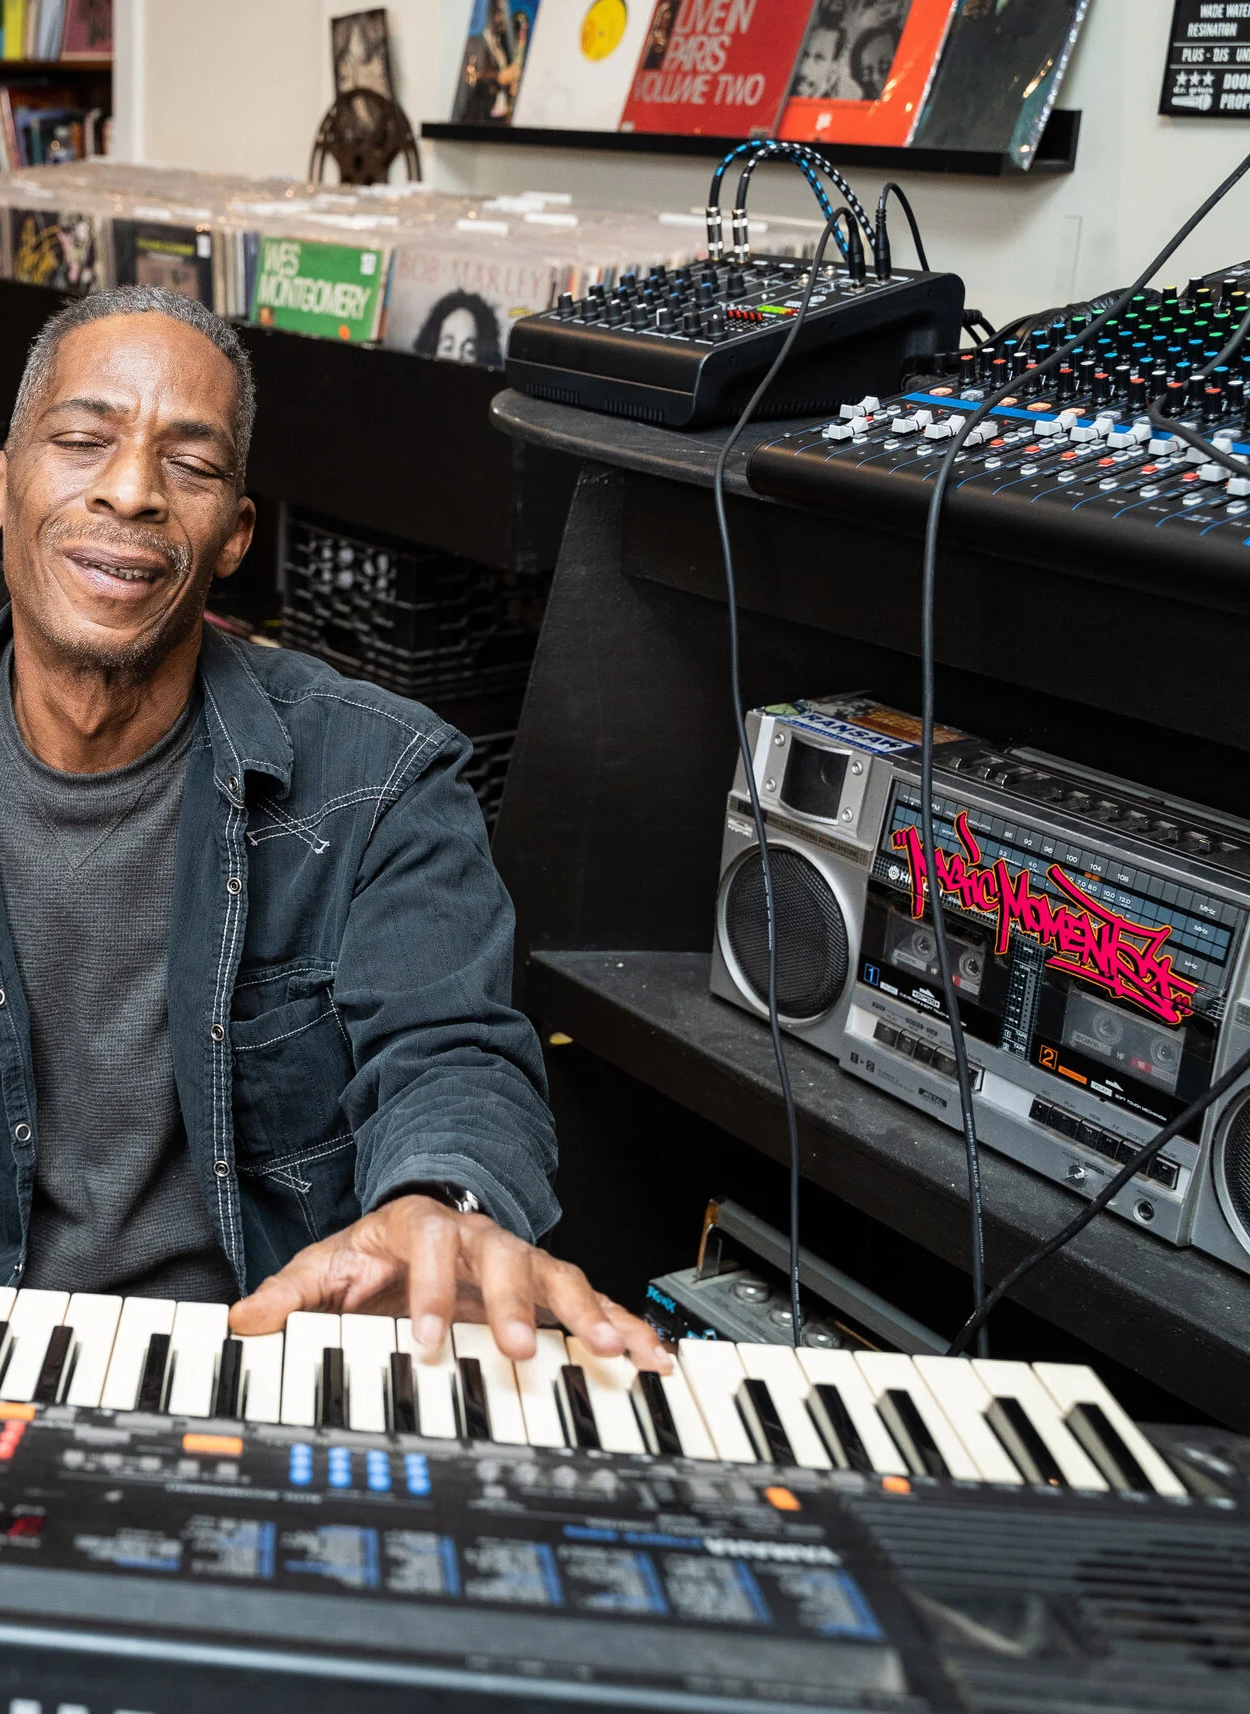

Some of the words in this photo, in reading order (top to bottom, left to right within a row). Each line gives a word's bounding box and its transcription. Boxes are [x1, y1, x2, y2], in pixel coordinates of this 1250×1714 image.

[674, 0, 731, 34] LIVE
[724, 0, 757, 34] IN
[1200, 3, 1225, 19] WADE
[1187, 22, 1238, 37] RESINATION
[661, 35, 732, 73] PARIS
[1181, 47, 1205, 62] PLUS
[1212, 47, 1230, 62] DJS
[633, 72, 712, 105] VOLUME
[713, 72, 766, 106] TWO
[263, 241, 301, 277] WES
[453, 259, 544, 300] MARLEY
[257, 273, 373, 321] MONTGOMERY
[1023, 838, 1033, 846] 92
[1066, 854, 1078, 863] 100
[1090, 863, 1102, 872] 104
[1199, 903, 1217, 916] MHz
[1077, 879, 1086, 887] 7.0
[1103, 890, 1116, 899] 10.0
[1119, 896, 1131, 905] 12.0
[1042, 1049, 1055, 1068] 2
[972, 1160, 980, 1188] CENTER
